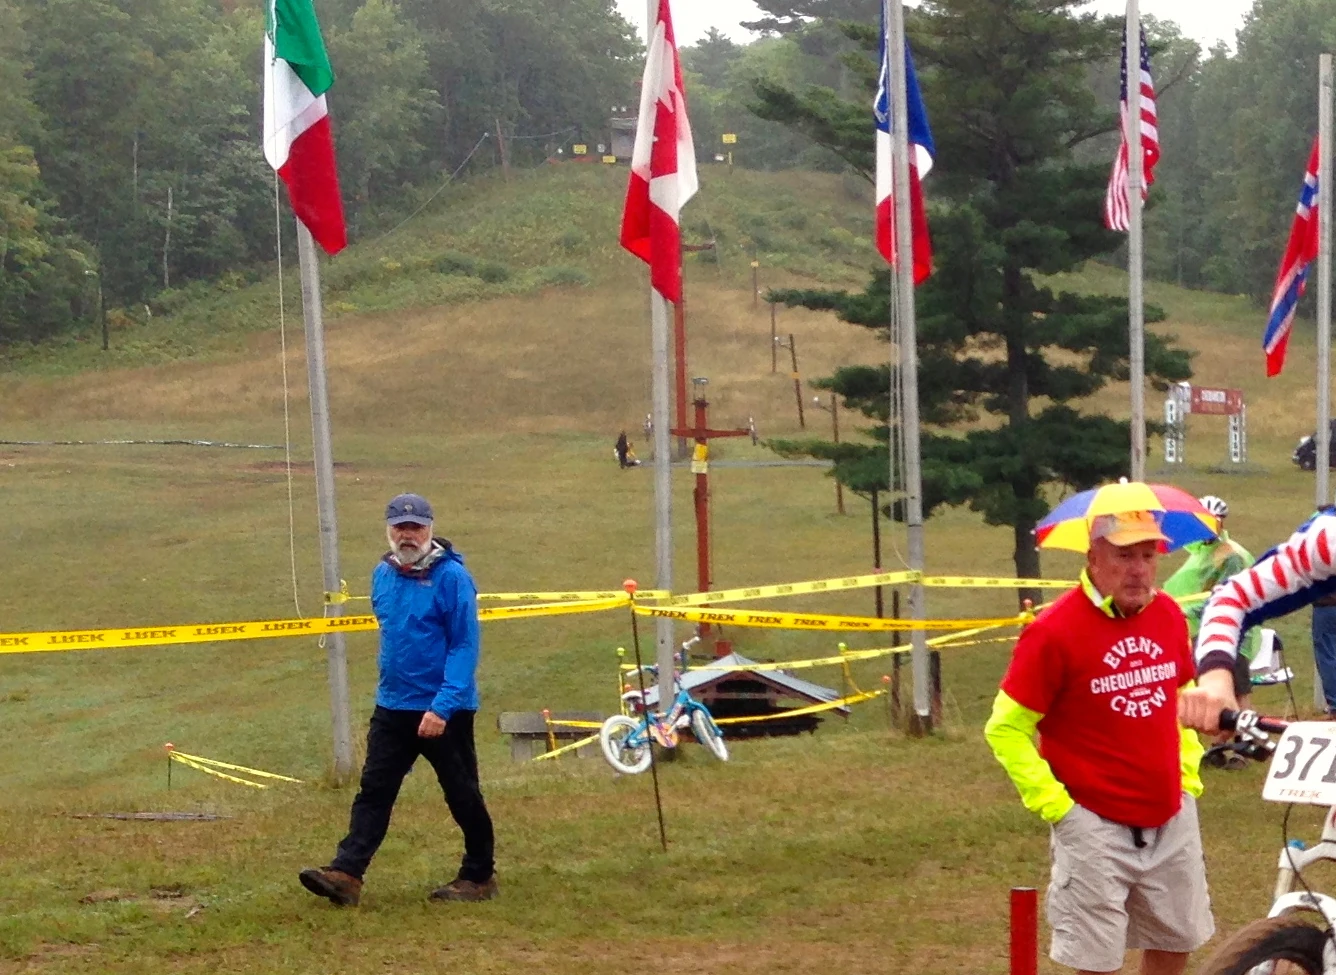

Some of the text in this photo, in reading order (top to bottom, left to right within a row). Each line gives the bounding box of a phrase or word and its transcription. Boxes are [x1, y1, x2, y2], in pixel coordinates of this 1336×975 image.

[650, 609, 687, 618] TREK
[700, 612, 735, 621] TREK
[748, 616, 782, 624] TREK
[793, 618, 828, 626] TREK
[1103, 636, 1163, 669] EVENT
[1090, 661, 1176, 694] CHEQUAMEGON
[1110, 686, 1167, 718] CREW
